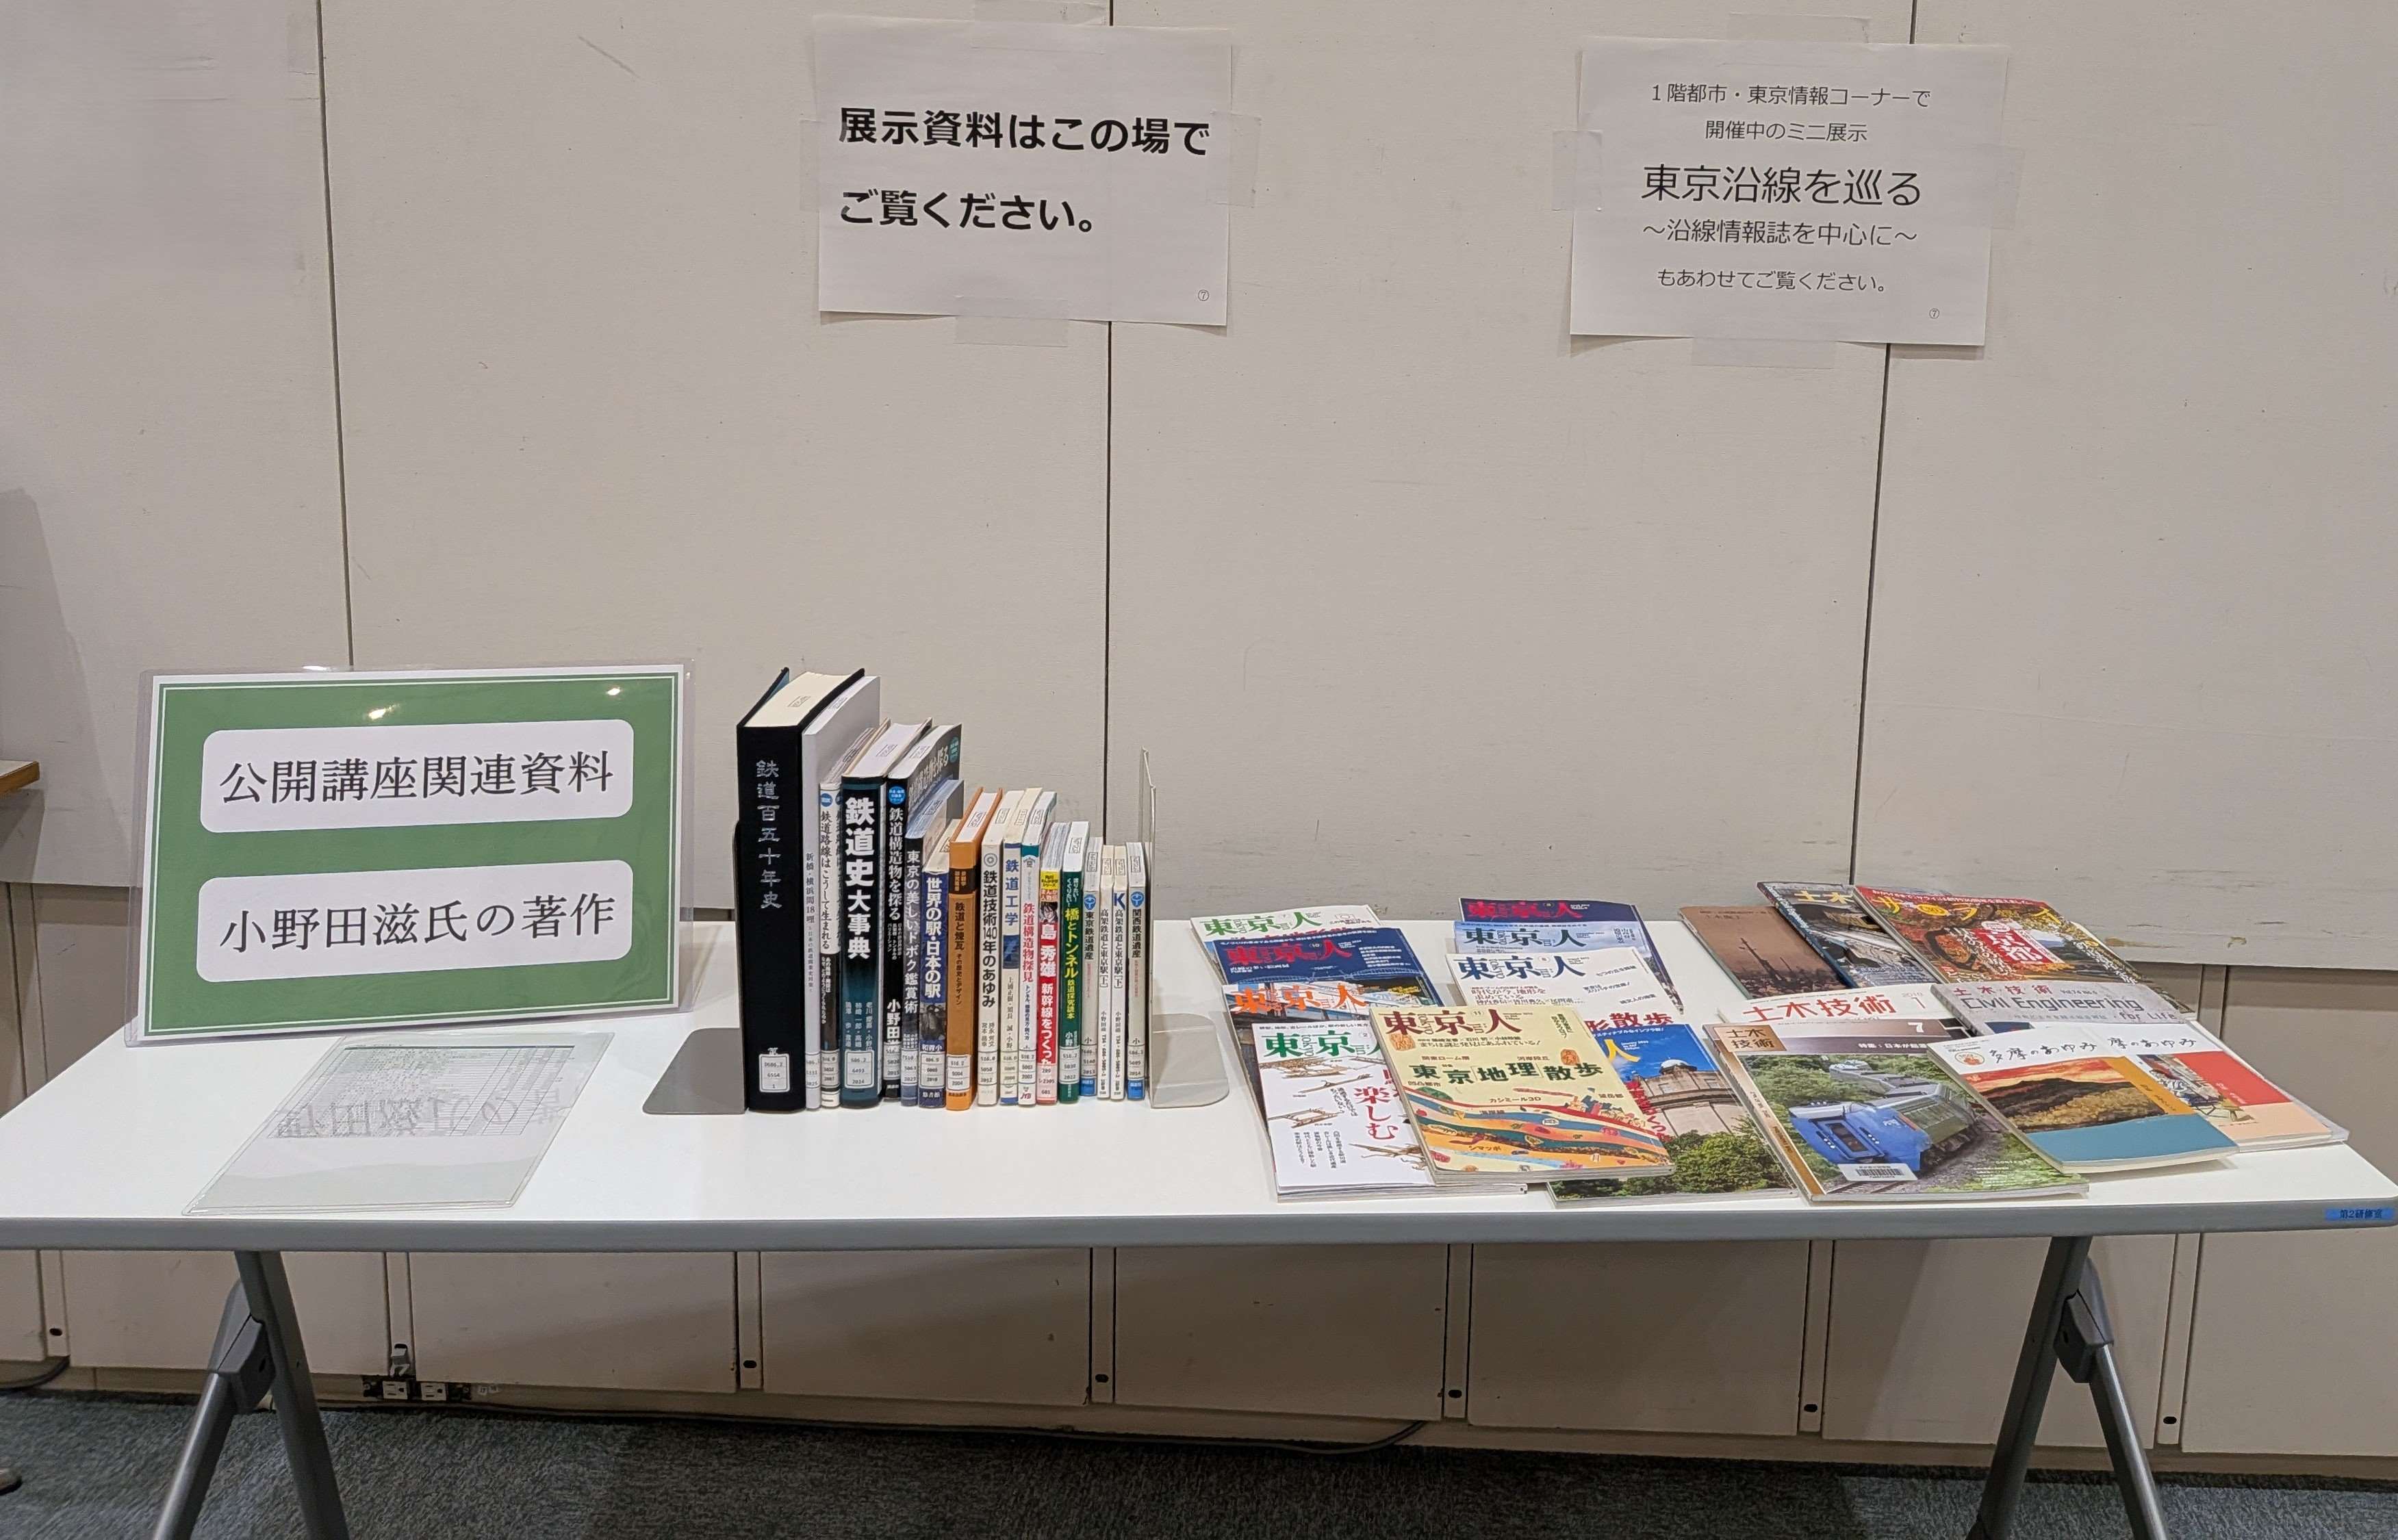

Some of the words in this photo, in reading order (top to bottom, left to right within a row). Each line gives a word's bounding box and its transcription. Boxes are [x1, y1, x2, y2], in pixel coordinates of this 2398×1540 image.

[839, 106, 1211, 156] 展示資料はこの場で
[1705, 119, 1868, 143] 開催中のミニ展示
[1641, 164, 1922, 207] 東京沿線を巡る
[840, 188, 1093, 233] ご覧ください。
[1656, 268, 1887, 293] もあわせてご覧ください。
[219, 750, 615, 806] 公開講座関連資料
[756, 759, 783, 910] 鉄道百五十年史
[821, 810, 832, 950] 鉄道路線はこうして生まれる
[845, 797, 876, 960] 鉄道史大事典
[889, 807, 904, 921] 鉄道構造物を探る
[1005, 858, 1019, 927] 鉄道工学
[1467, 901, 1584, 920] 東京人
[219, 893, 617, 954] 小野田滋氏の著作
[904, 850, 921, 1014] 東京の美しいドボク鑑賞術
[925, 877, 943, 999] 世界の駅・日本の駅
[954, 902, 965, 951] 鉄道と煉瓦
[982, 870, 997, 1008] 鉄道技術140年のあゆみ
[1022, 902, 1035, 983] 鉄道構造物探見
[1064, 908, 1080, 979] 橋とトンネル
[1084, 911, 1094, 960] 東京鉄道遺産
[1132, 909, 1142, 958] 関西鉄道遺産
[1200, 911, 1323, 936] 東京人
[1462, 927, 1587, 947] 東京人
[1224, 939, 1353, 966] 東京人
[1453, 955, 1586, 980] 東京人
[1228, 985, 1369, 1014] 東京人
[1742, 994, 1897, 1023] 土木技術
[1954, 985, 2053, 997] 土木技術
[1961, 997, 2011, 1010] Civil
[2011, 997, 2144, 1012] Engineering
[1377, 1008, 1522, 1036] 東京人
[1726, 1028, 1766, 1039] 土木
[1731, 1038, 1775, 1049] 技術
[1907, 1021, 1924, 1034] 7
[1408, 1062, 1603, 1085] 東京地理散歩
[1989, 1041, 2097, 1064] 多摩のあゆみ
[1354, 1086, 1399, 1140] 楽しむ
